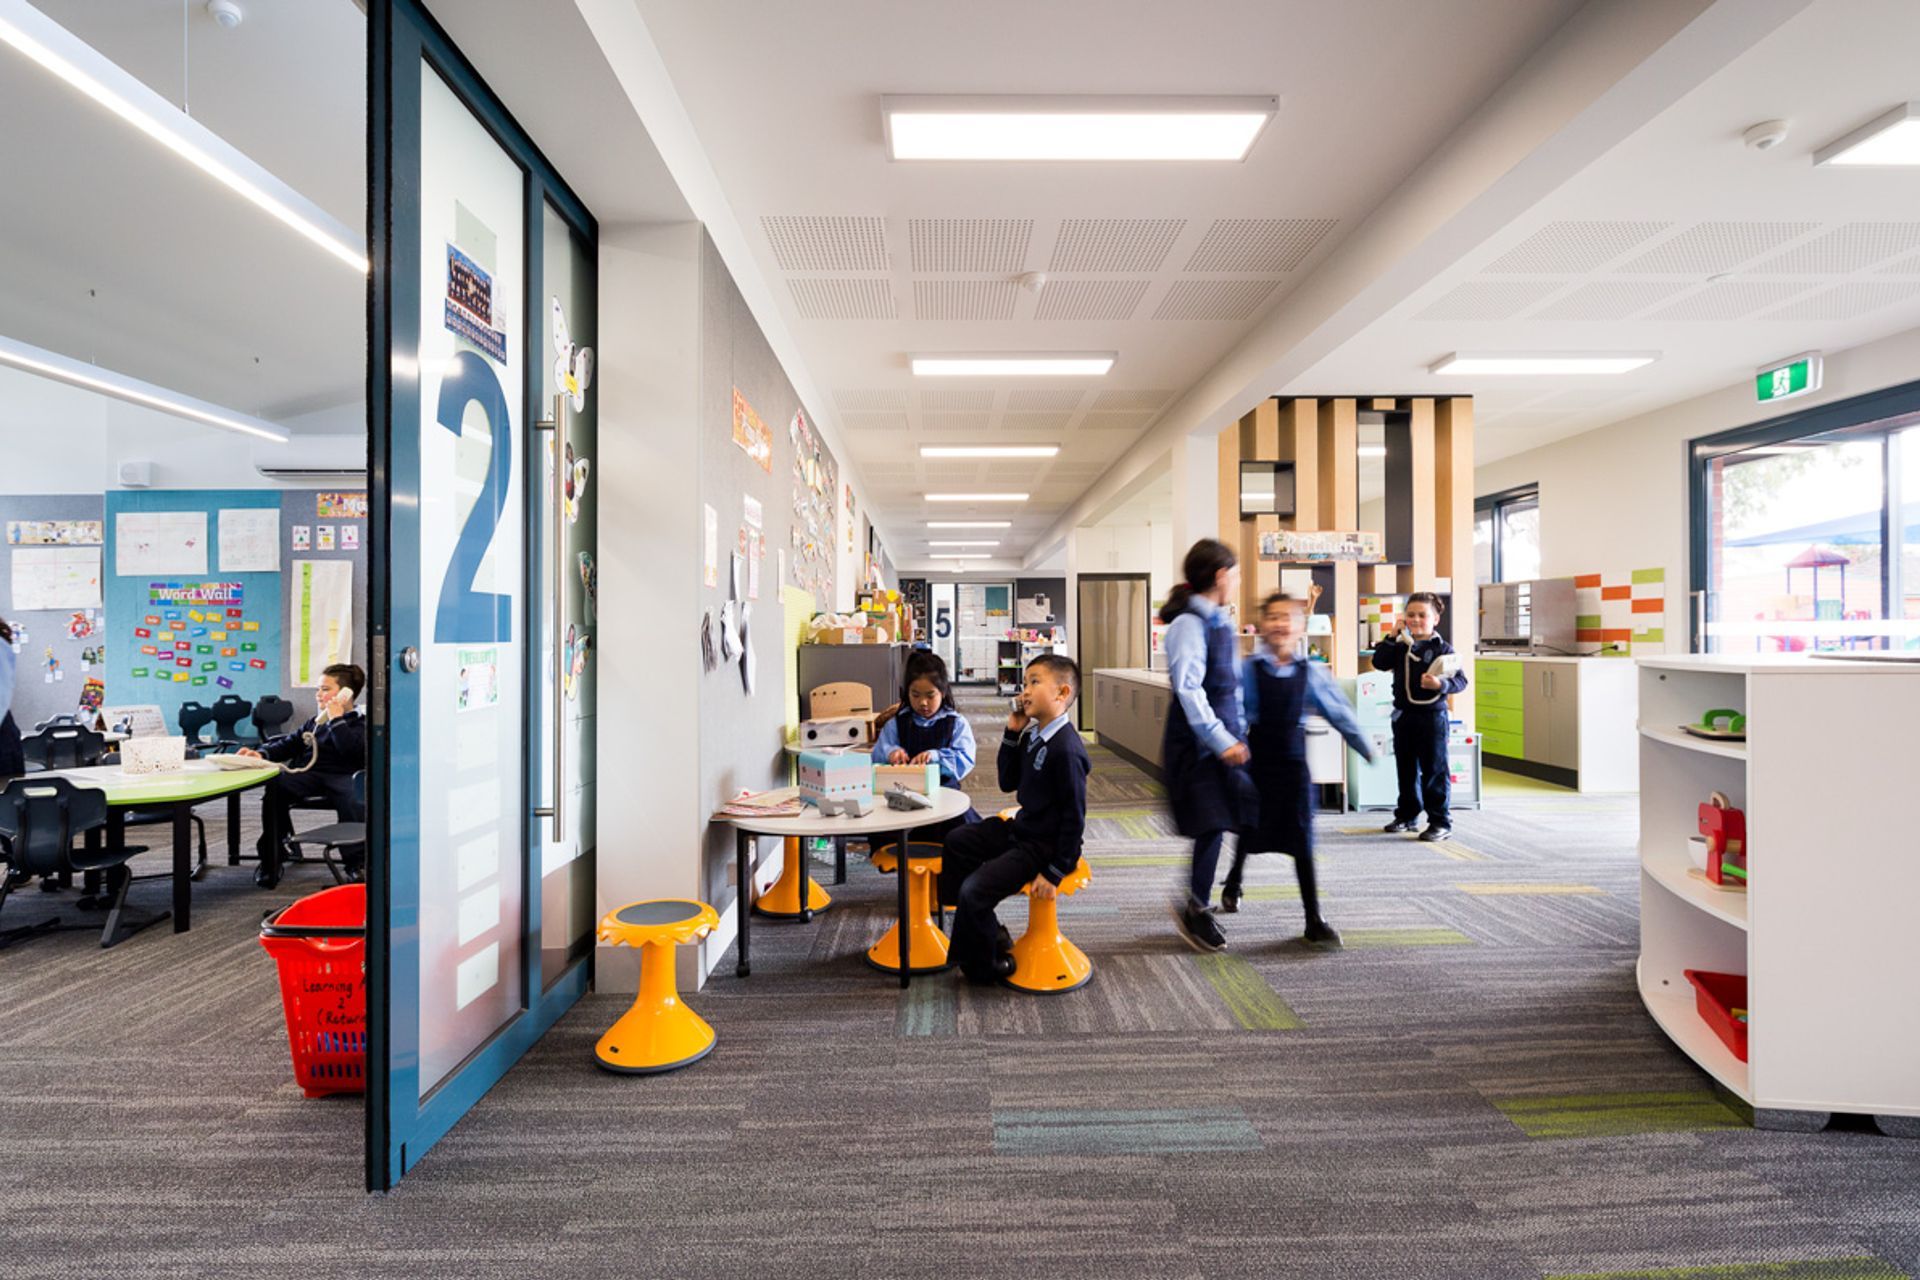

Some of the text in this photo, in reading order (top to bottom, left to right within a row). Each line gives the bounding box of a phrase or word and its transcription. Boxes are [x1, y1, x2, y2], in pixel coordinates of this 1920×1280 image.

[434, 350, 512, 643] 2
[159, 588, 232, 600] Word Wall
[935, 608, 951, 638] 5
[303, 979, 353, 999] Learning
[337, 997, 345, 1008] 2
